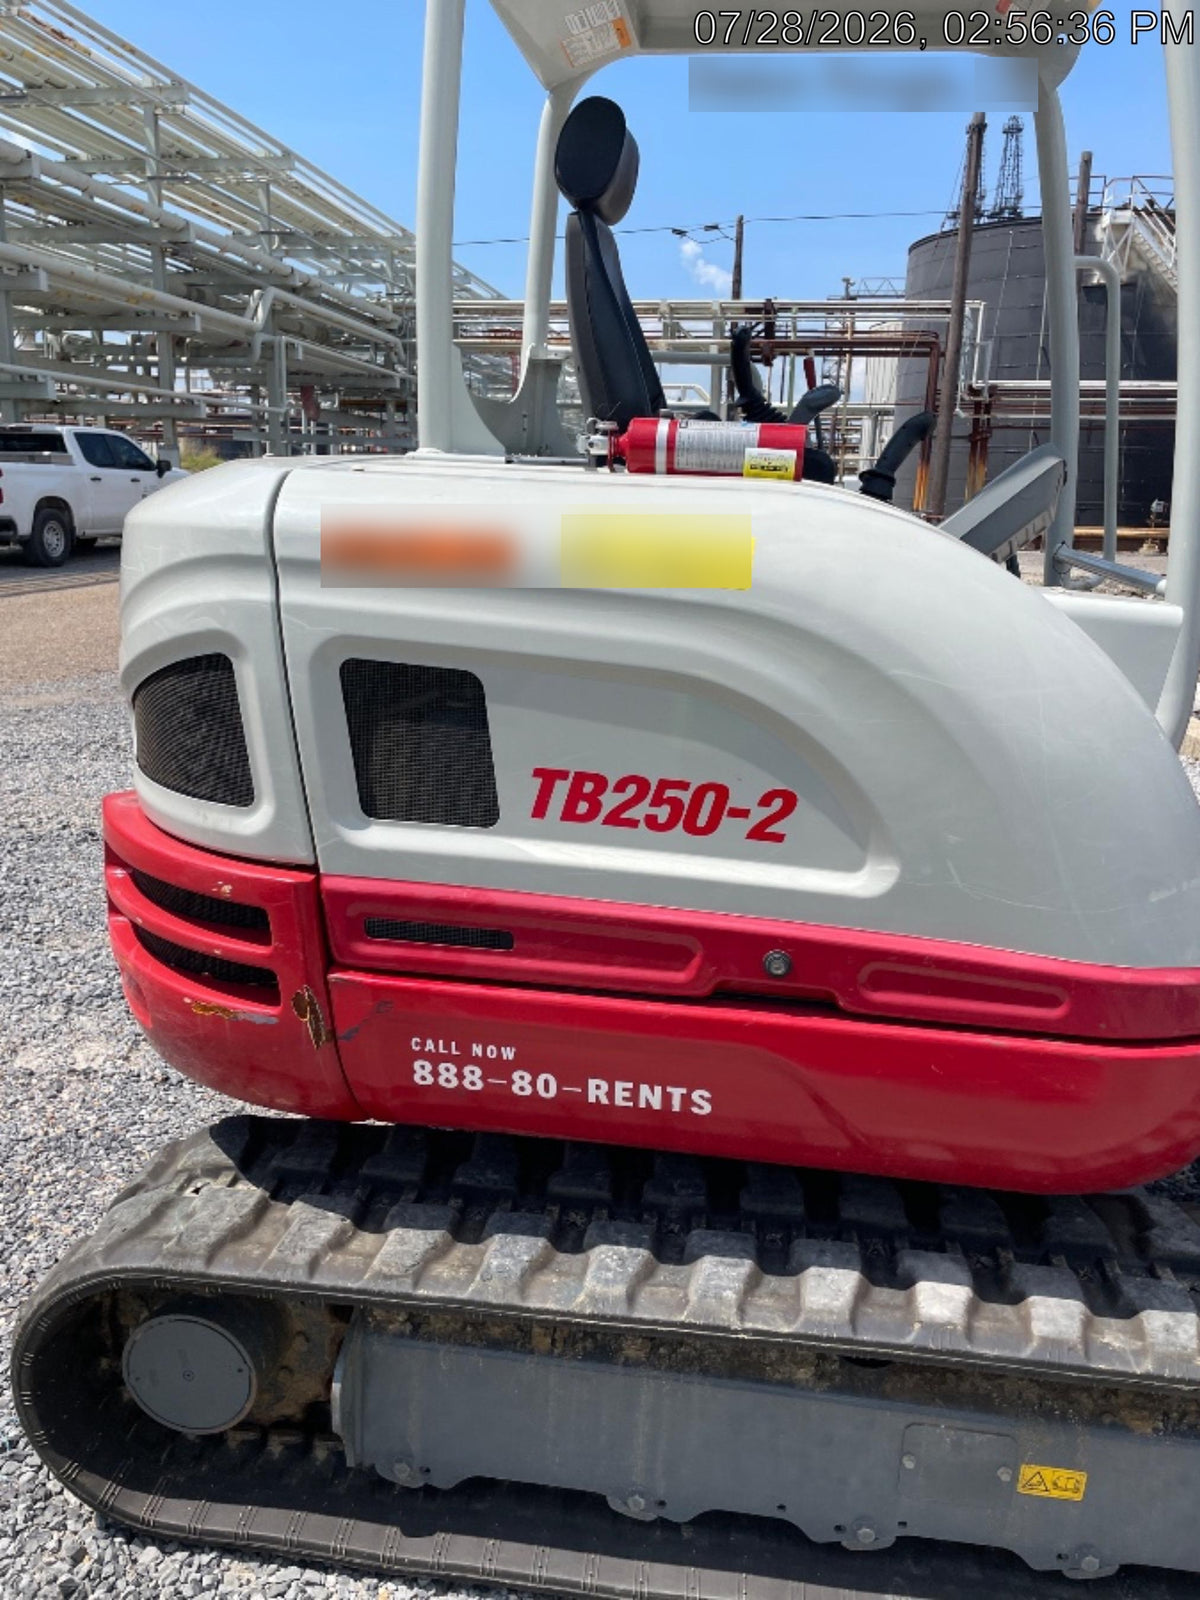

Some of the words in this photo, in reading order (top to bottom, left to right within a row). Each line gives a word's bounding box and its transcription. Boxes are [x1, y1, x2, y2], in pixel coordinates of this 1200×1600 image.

[531, 767, 798, 843] TB250-2
[410, 1037, 461, 1056] CALL
[472, 1042, 517, 1061] NOW
